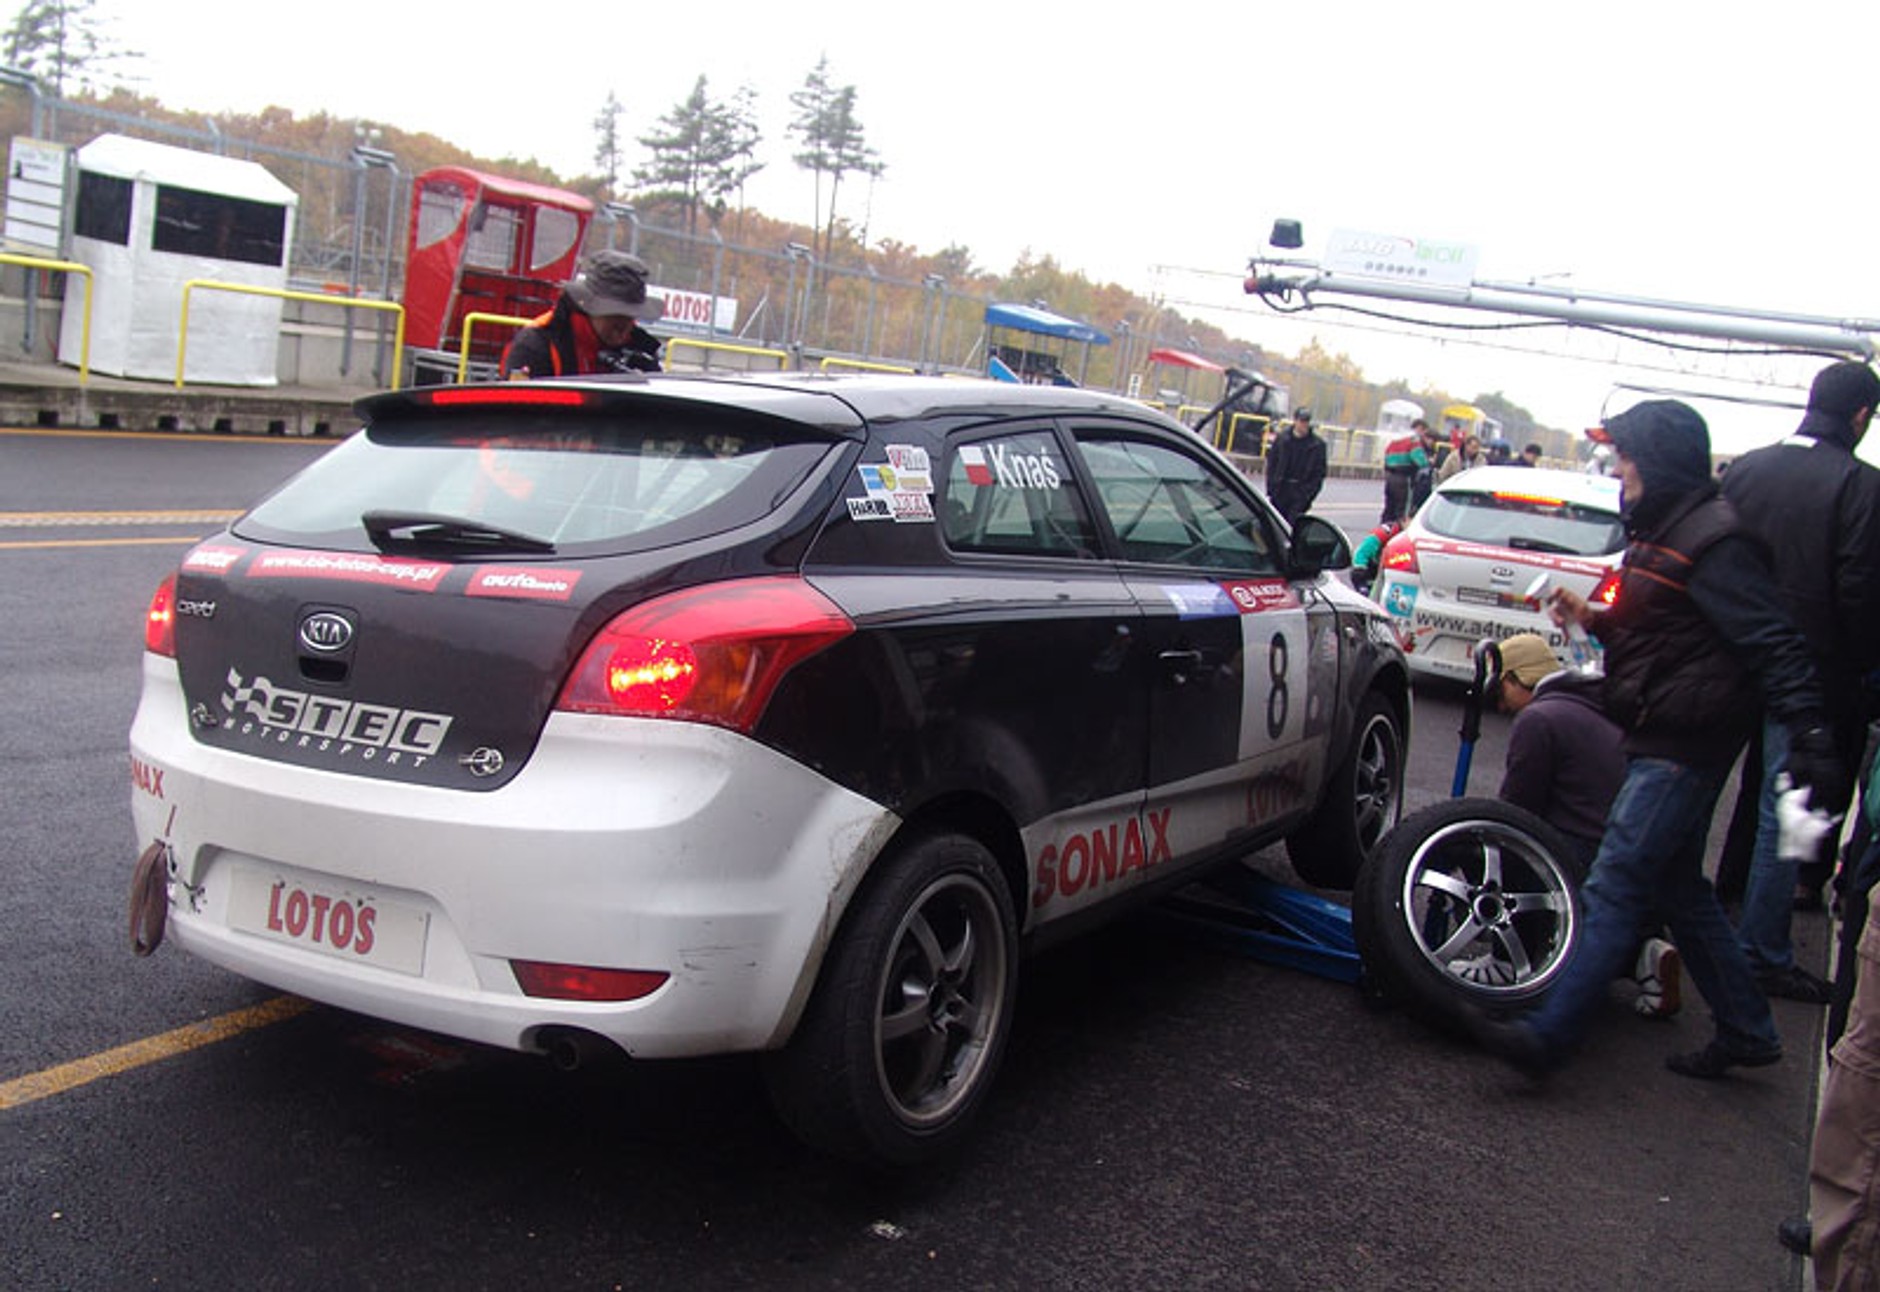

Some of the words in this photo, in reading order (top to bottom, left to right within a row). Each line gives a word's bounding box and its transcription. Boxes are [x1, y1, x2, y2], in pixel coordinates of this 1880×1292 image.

[663, 292, 712, 323] LOTOS
[988, 443, 1060, 490] Knaś
[309, 616, 344, 645] KIA
[1267, 632, 1289, 740] 8
[222, 717, 429, 769] MOTORSPORT
[262, 688, 450, 754] STEC
[1032, 808, 1173, 909] SONAX
[267, 883, 377, 955] LOTOS
